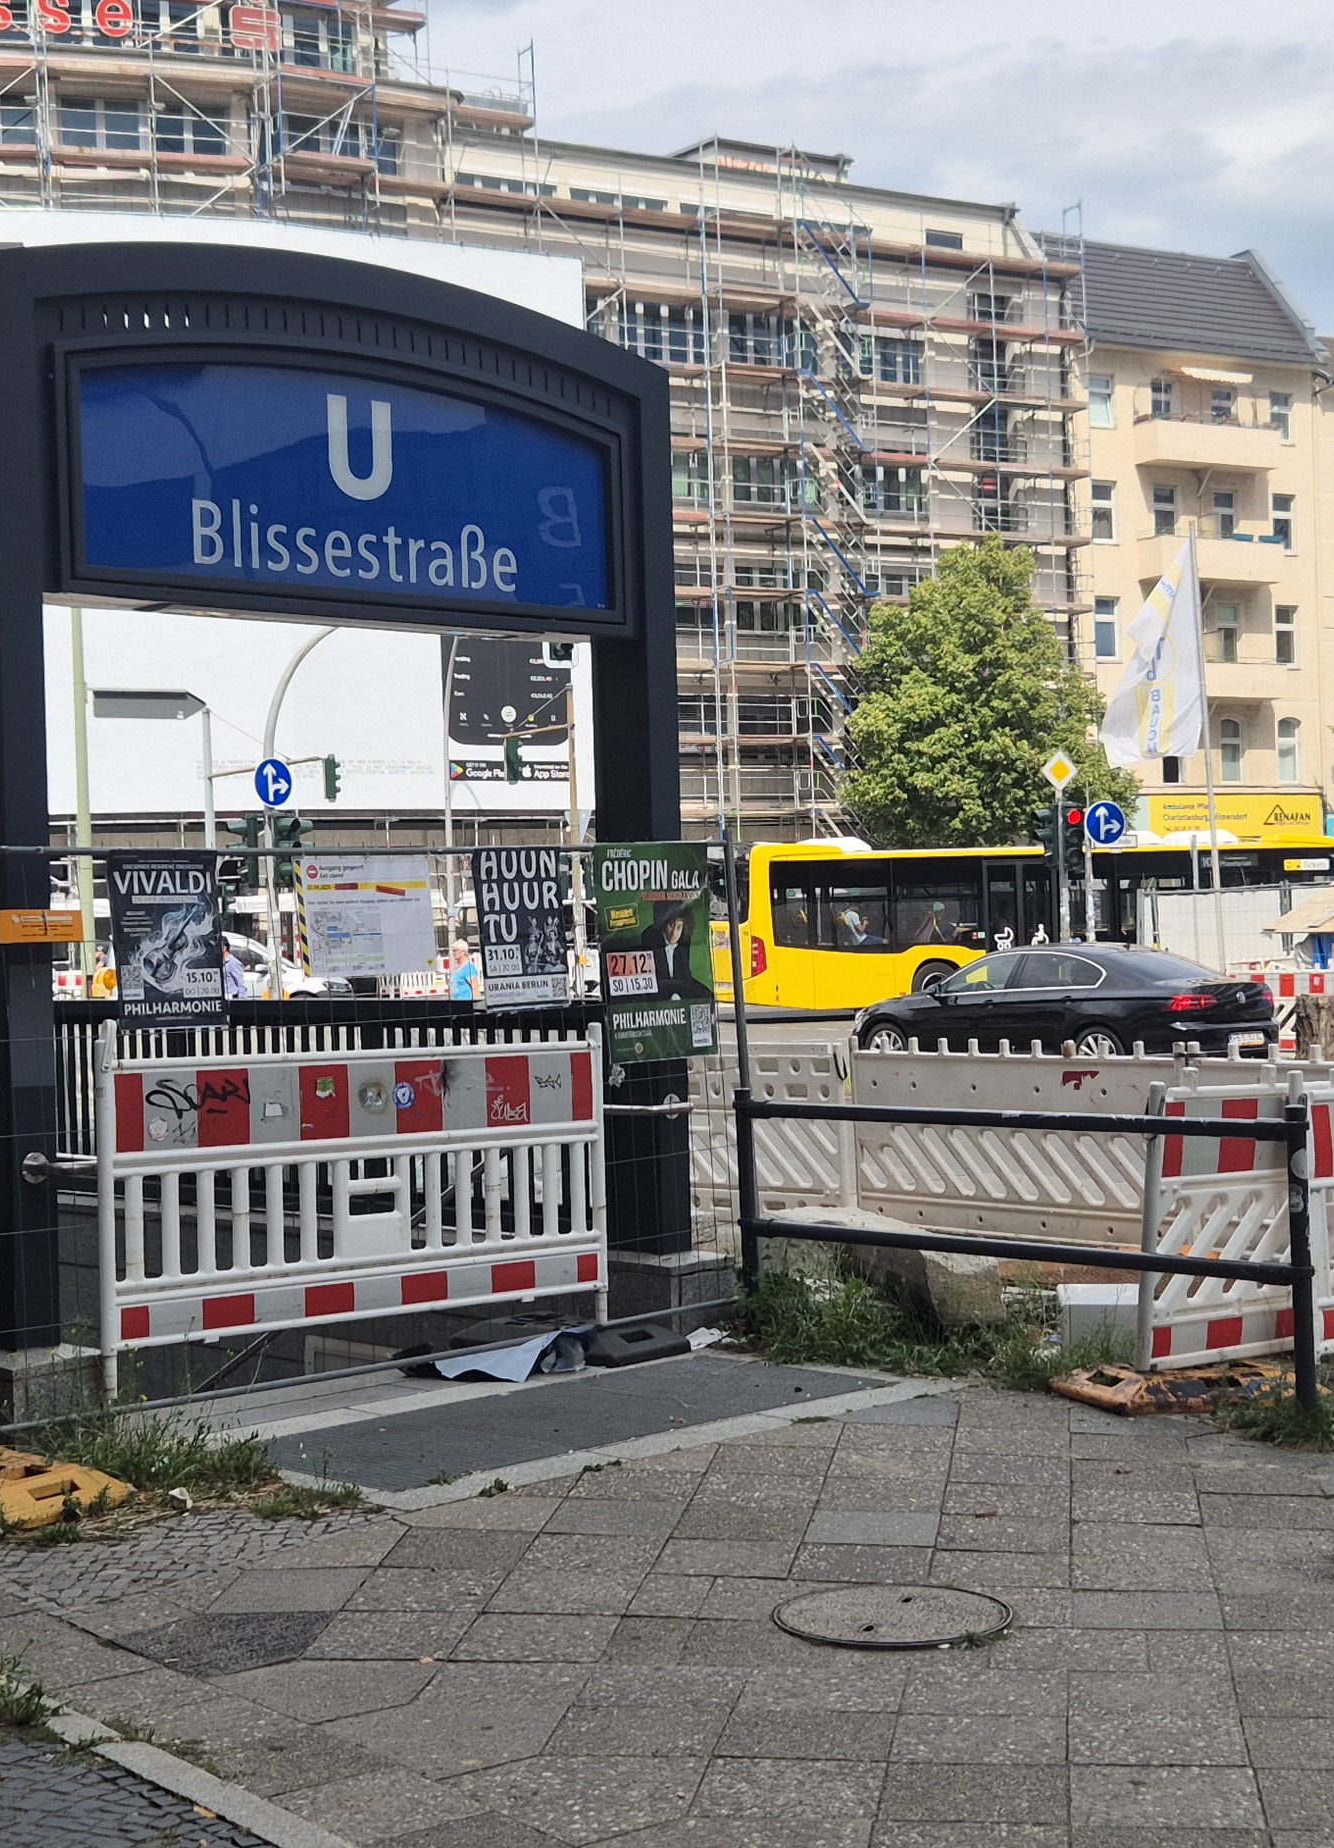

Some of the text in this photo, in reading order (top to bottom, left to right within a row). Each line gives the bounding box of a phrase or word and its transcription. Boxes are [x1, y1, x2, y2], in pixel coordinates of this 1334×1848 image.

[326, 393, 393, 501] U
[191, 497, 518, 594] Blissestraße
[466, 768, 505, 779] Google Pla
[533, 769, 550, 779] App
[1273, 812, 1311, 821] RENAFAN
[480, 850, 557, 881] HUUN
[1304, 860, 1327, 868] Tickets
[113, 870, 212, 895] VIVALDI
[601, 859, 700, 892] CHOPIN GALA
[482, 881, 559, 912] HUUR
[483, 913, 518, 944] TU
[487, 948, 519, 961] 31.10.
[610, 953, 652, 976] 27.12.
[186, 971, 216, 984] 15.10.
[488, 980, 549, 993] URANIA BERLIN
[613, 976, 653, 993] SO 15.30
[124, 1001, 222, 1015] PHILHARMONIE
[612, 1008, 687, 1031] PHILHARMONIE
